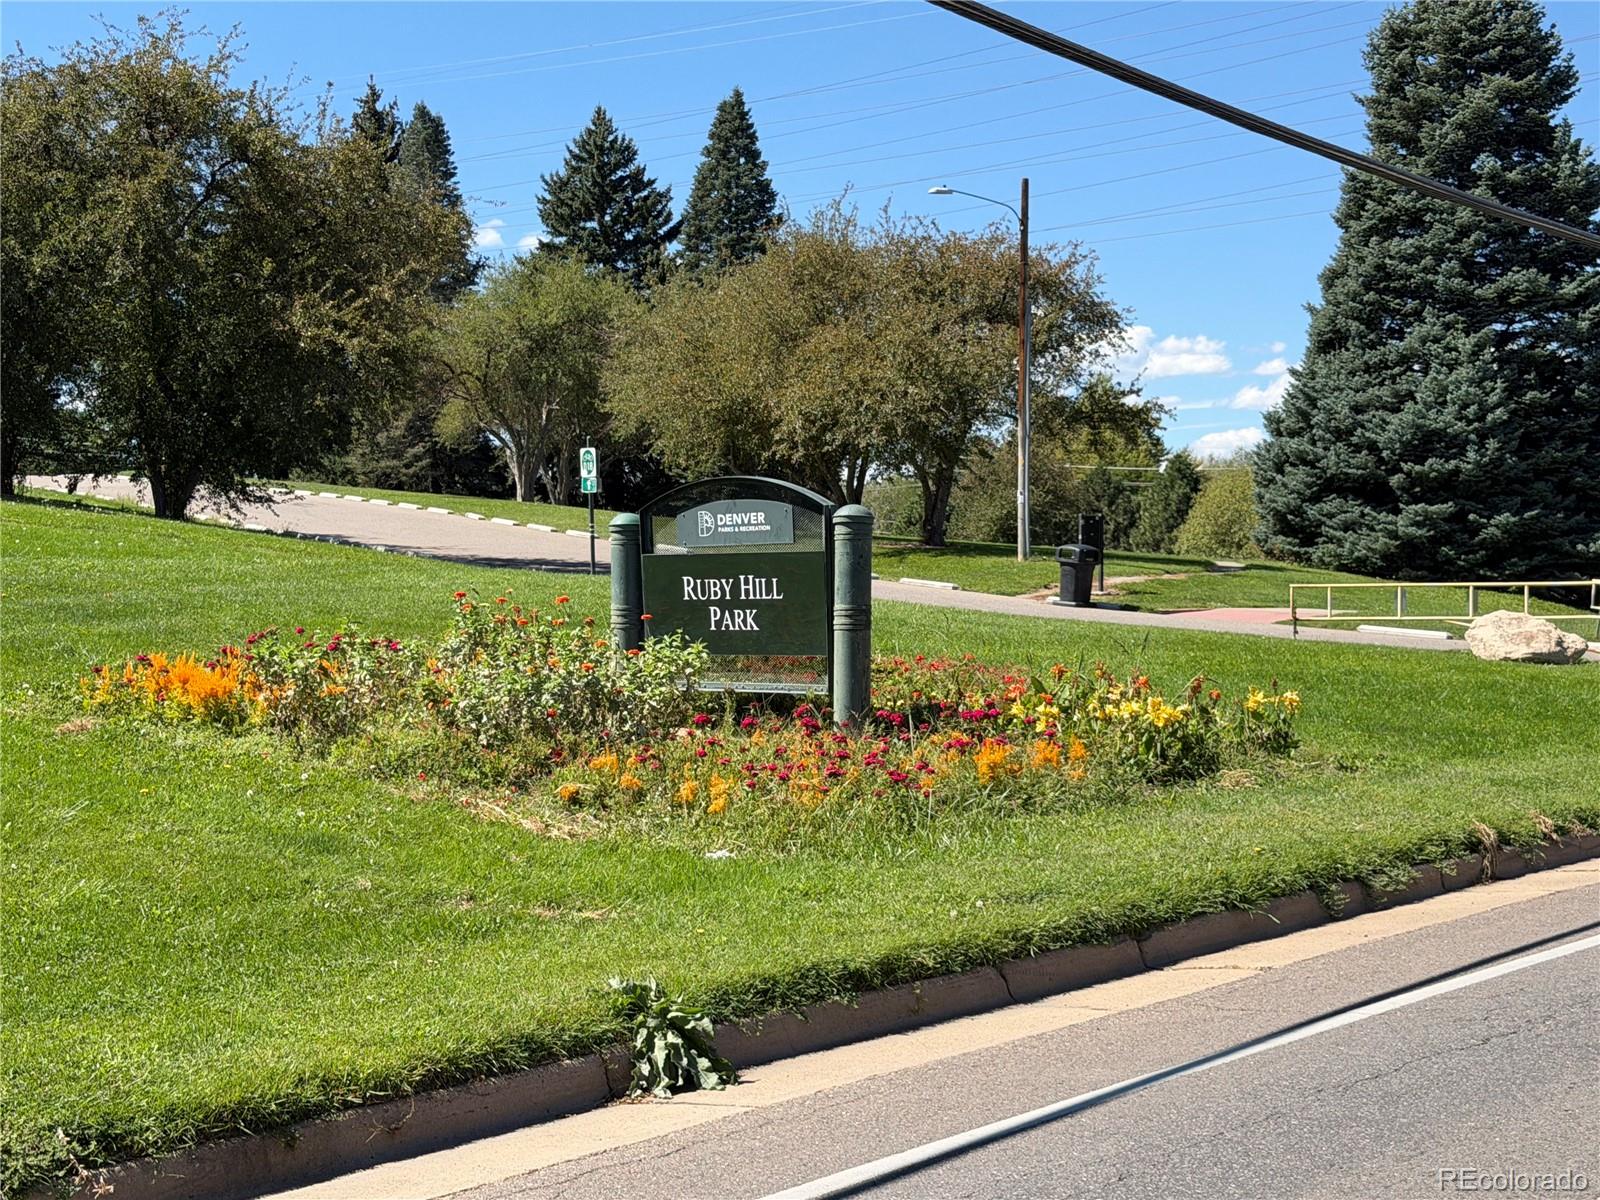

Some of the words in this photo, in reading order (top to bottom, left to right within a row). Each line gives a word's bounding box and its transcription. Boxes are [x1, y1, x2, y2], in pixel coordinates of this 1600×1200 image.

[717, 512, 766, 526] DENVER
[681, 576, 734, 601] RUBY
[738, 575, 784, 600] HILL
[708, 606, 760, 631] PARK
